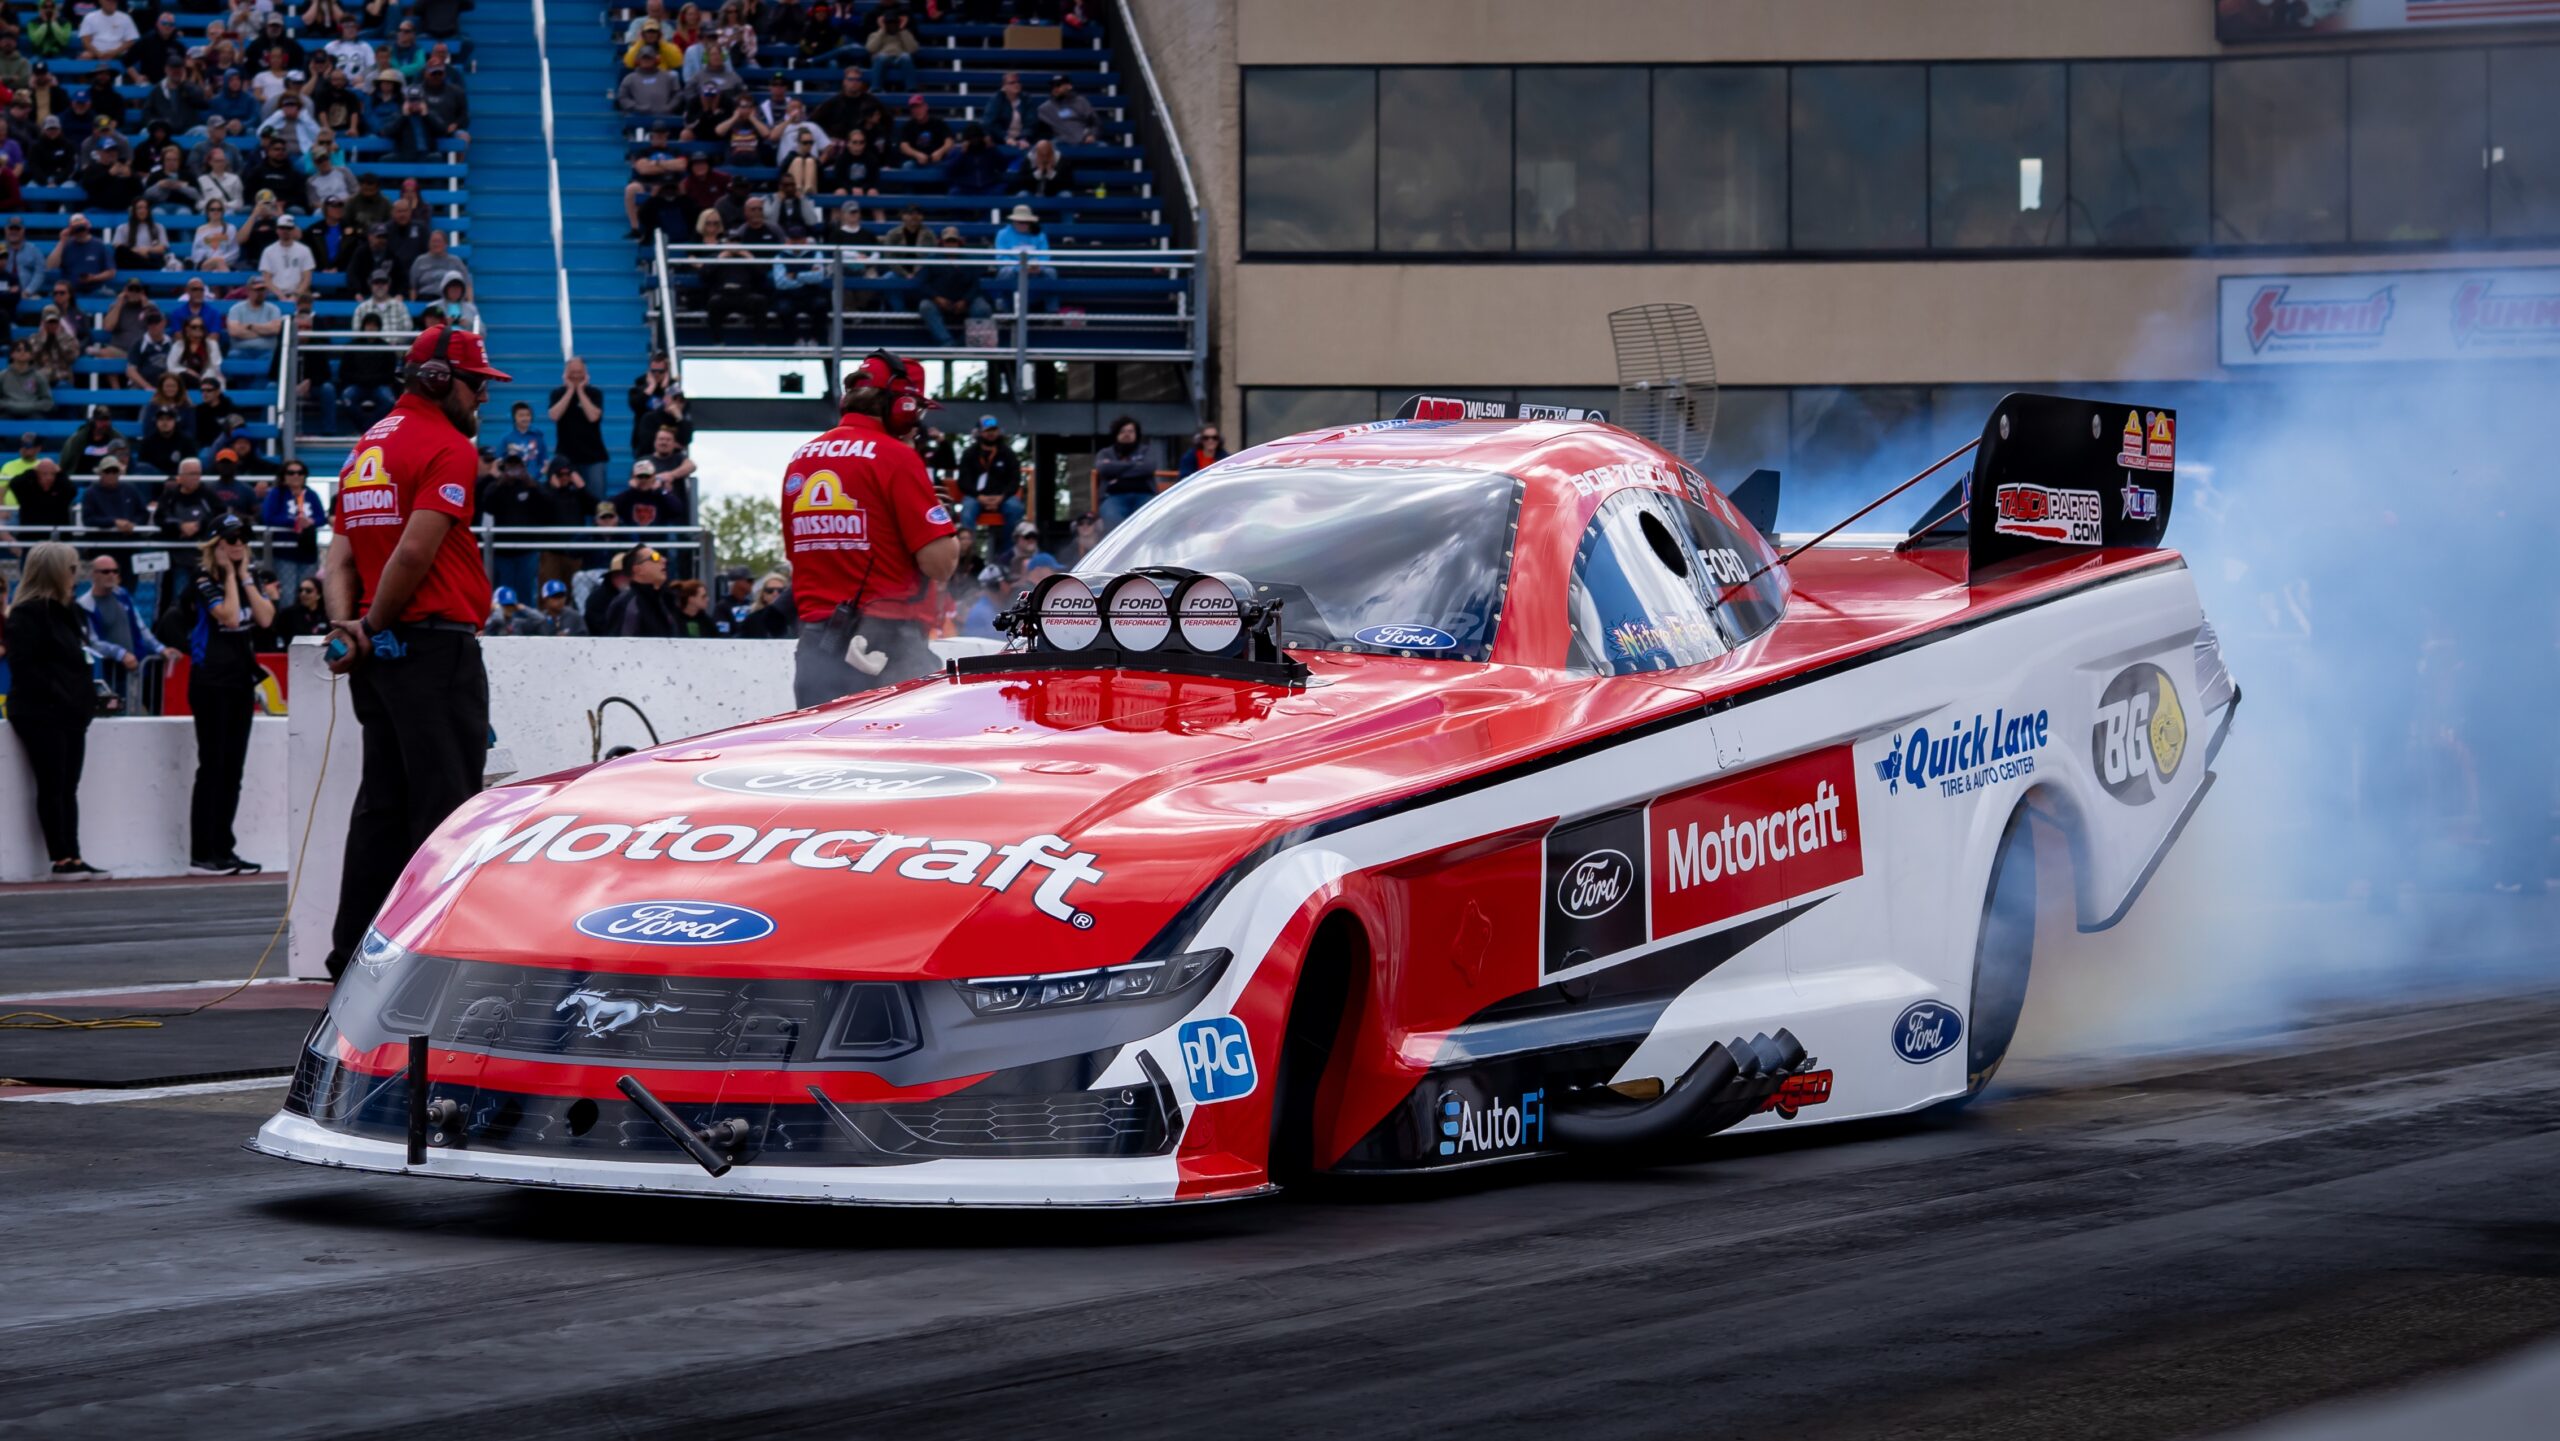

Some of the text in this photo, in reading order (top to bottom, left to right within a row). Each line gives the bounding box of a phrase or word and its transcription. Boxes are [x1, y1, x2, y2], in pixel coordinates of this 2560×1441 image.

[1466, 401, 1506, 418] WILSON
[1569, 466, 1615, 497] BOB
[1612, 463, 1667, 488] TASCA
[2070, 523, 2100, 542] .COM
[1698, 548, 1751, 586] FORD
[1050, 598, 1095, 610] FORD
[1118, 598, 1163, 610] FORD
[1189, 598, 1234, 610] FORD
[1045, 618, 1099, 627] PERFORMANCE
[1113, 618, 1168, 627] PERFORMANCE
[1183, 618, 1238, 627] PERFORMANCE
[1374, 626, 1437, 646] Ford
[1904, 708, 2049, 789] Quick Lane
[2093, 691, 2151, 785] BG
[744, 763, 946, 794] Ford
[1940, 755, 2035, 798] TIRE & AUTO CENTER
[1571, 858, 1621, 911] Ford
[607, 904, 740, 939] Ford
[1905, 1010, 1944, 1053] Ford
[1457, 1087, 1544, 1154] AutoFi
